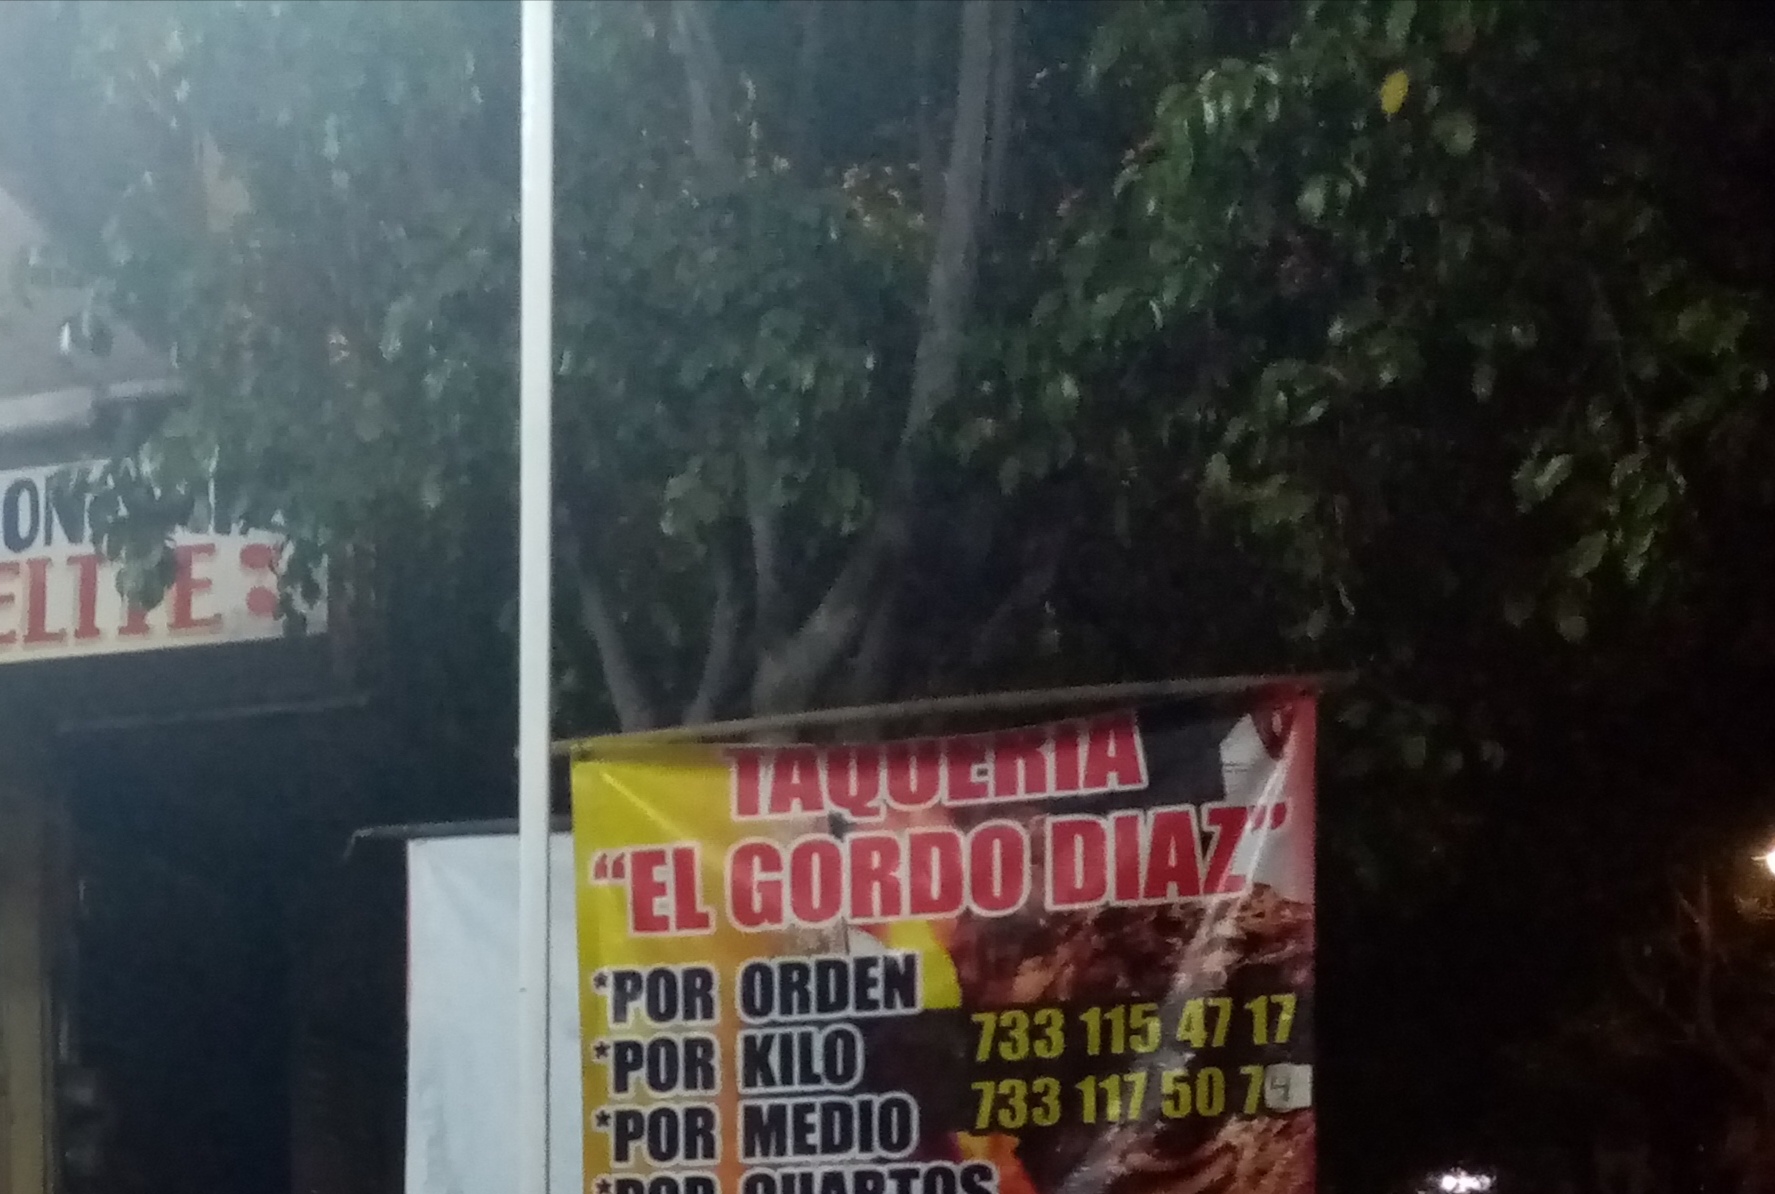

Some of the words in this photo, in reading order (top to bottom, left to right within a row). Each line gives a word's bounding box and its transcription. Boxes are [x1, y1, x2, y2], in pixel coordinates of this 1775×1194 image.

[724, 708, 1147, 818] TAQUERIA
[729, 822, 1029, 930] GORDO
[739, 954, 918, 1019] ORDEN
[740, 1027, 857, 1089] KILO
[972, 1008, 1065, 1061] 733
[1079, 1004, 1162, 1055] 115
[1177, 997, 1232, 1048] 47
[1244, 993, 1297, 1046] 17
[741, 1094, 914, 1159] MEDIO
[971, 1077, 1062, 1130] 733
[1076, 1071, 1148, 1124] 117
[1161, 1066, 1225, 1119] 50
